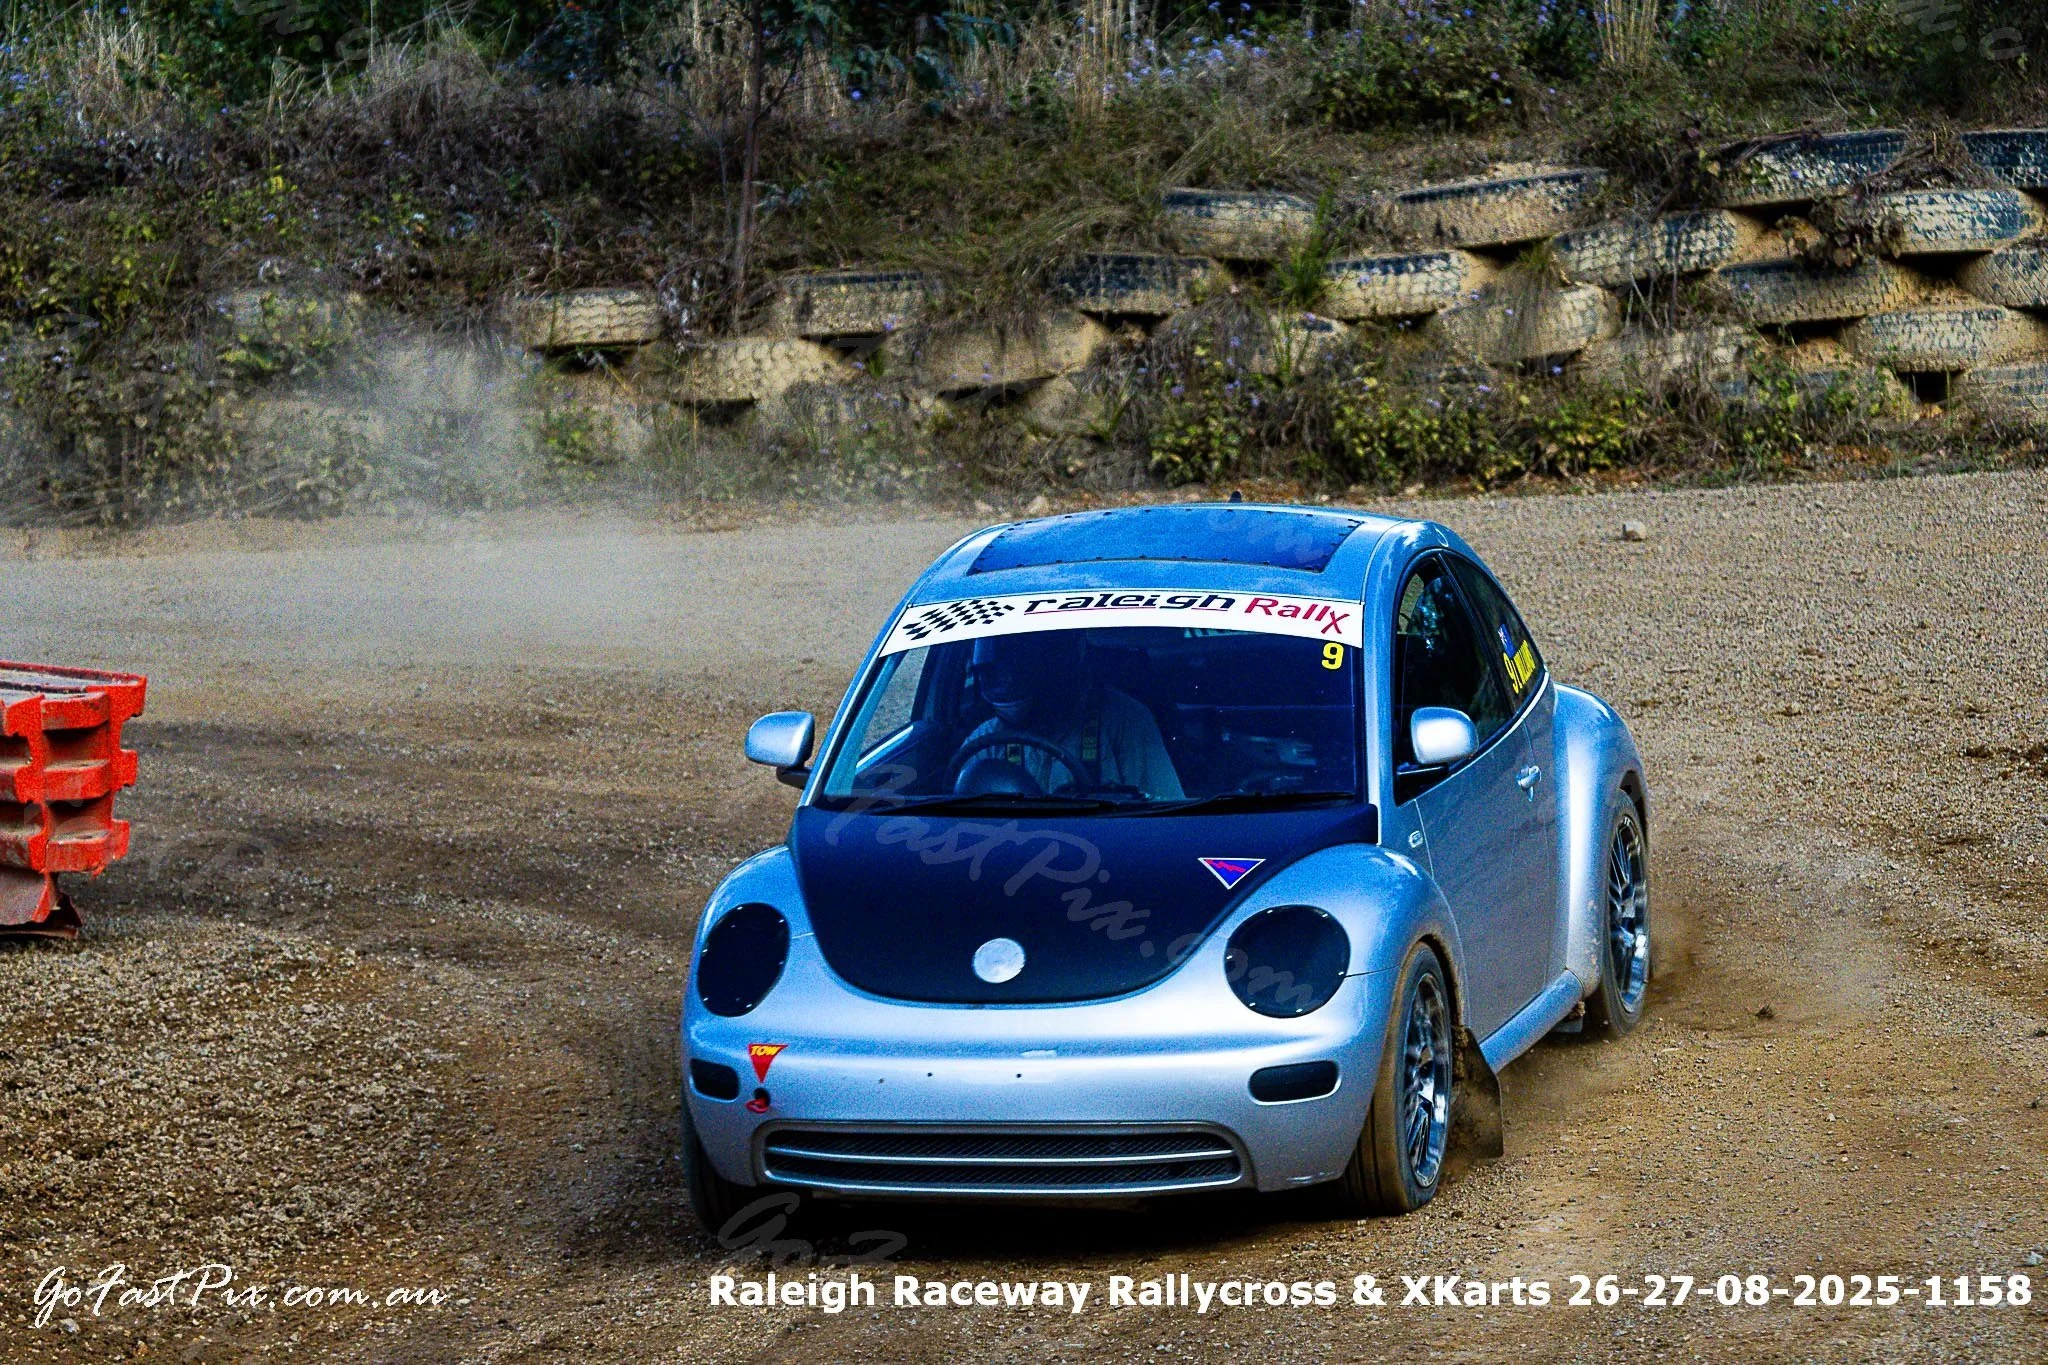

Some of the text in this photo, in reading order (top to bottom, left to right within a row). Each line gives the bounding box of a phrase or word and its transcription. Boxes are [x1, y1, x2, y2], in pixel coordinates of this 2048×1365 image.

[1023, 592, 1235, 613] raleigh
[1322, 641, 1344, 670] 9
[750, 1045, 782, 1056] TOW
